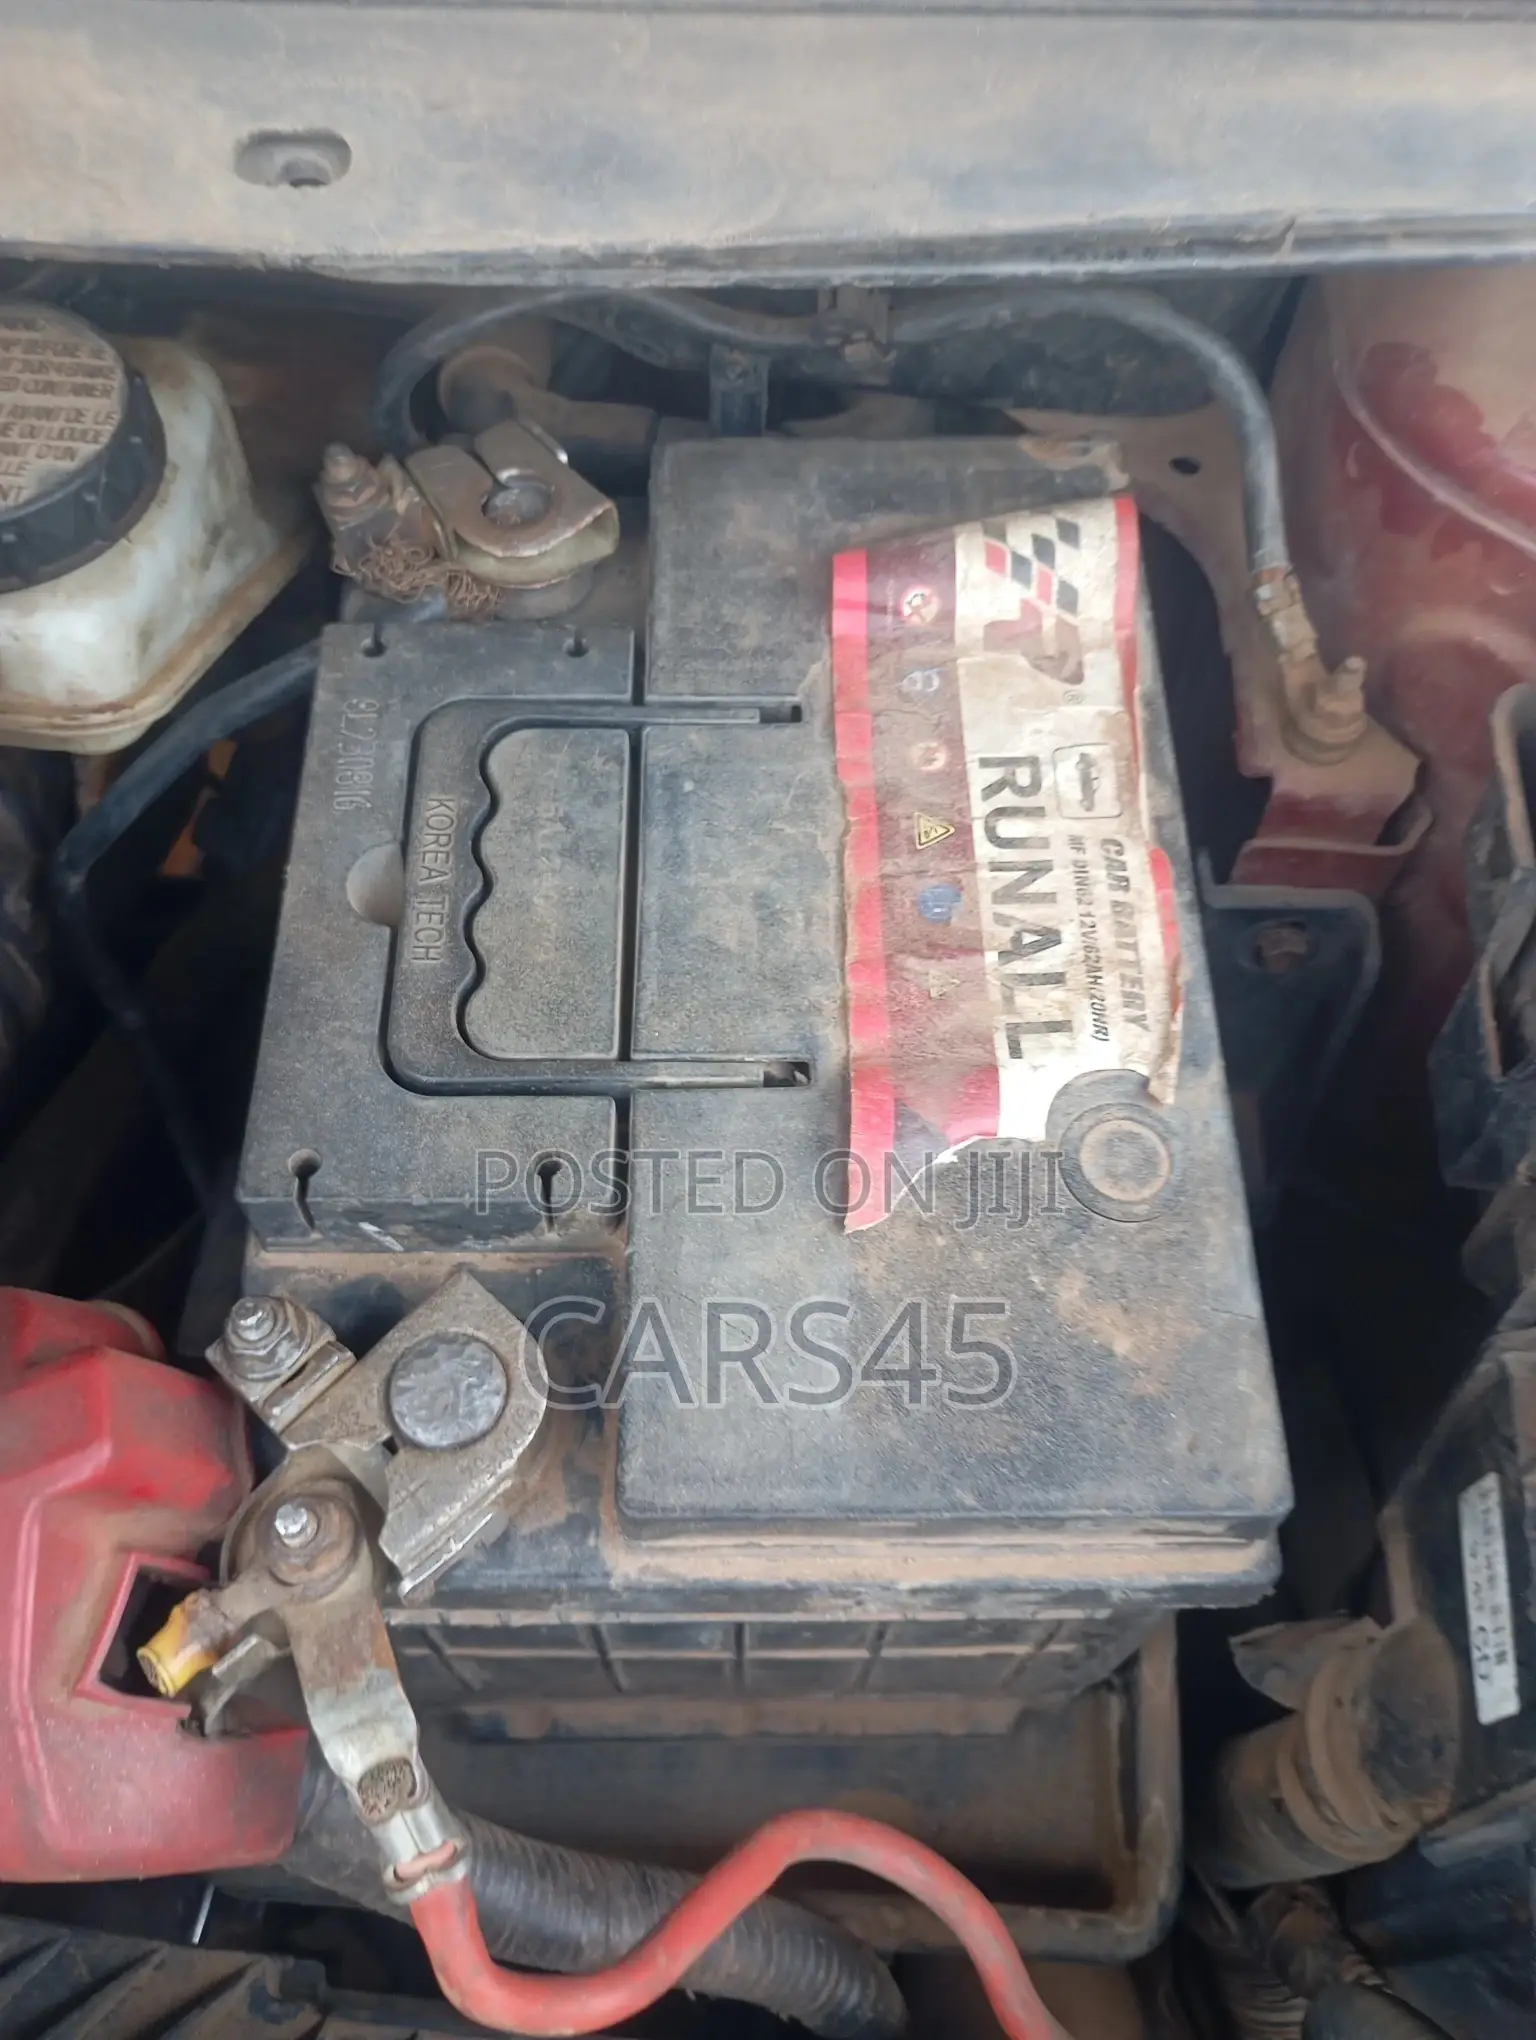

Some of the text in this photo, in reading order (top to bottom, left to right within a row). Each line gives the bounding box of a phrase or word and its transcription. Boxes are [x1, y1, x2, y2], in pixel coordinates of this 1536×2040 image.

[410, 797, 456, 963] KOREA TECH
[979, 756, 1075, 1061] RUNALL
[1099, 837, 1152, 1034] CAR BATTERY
